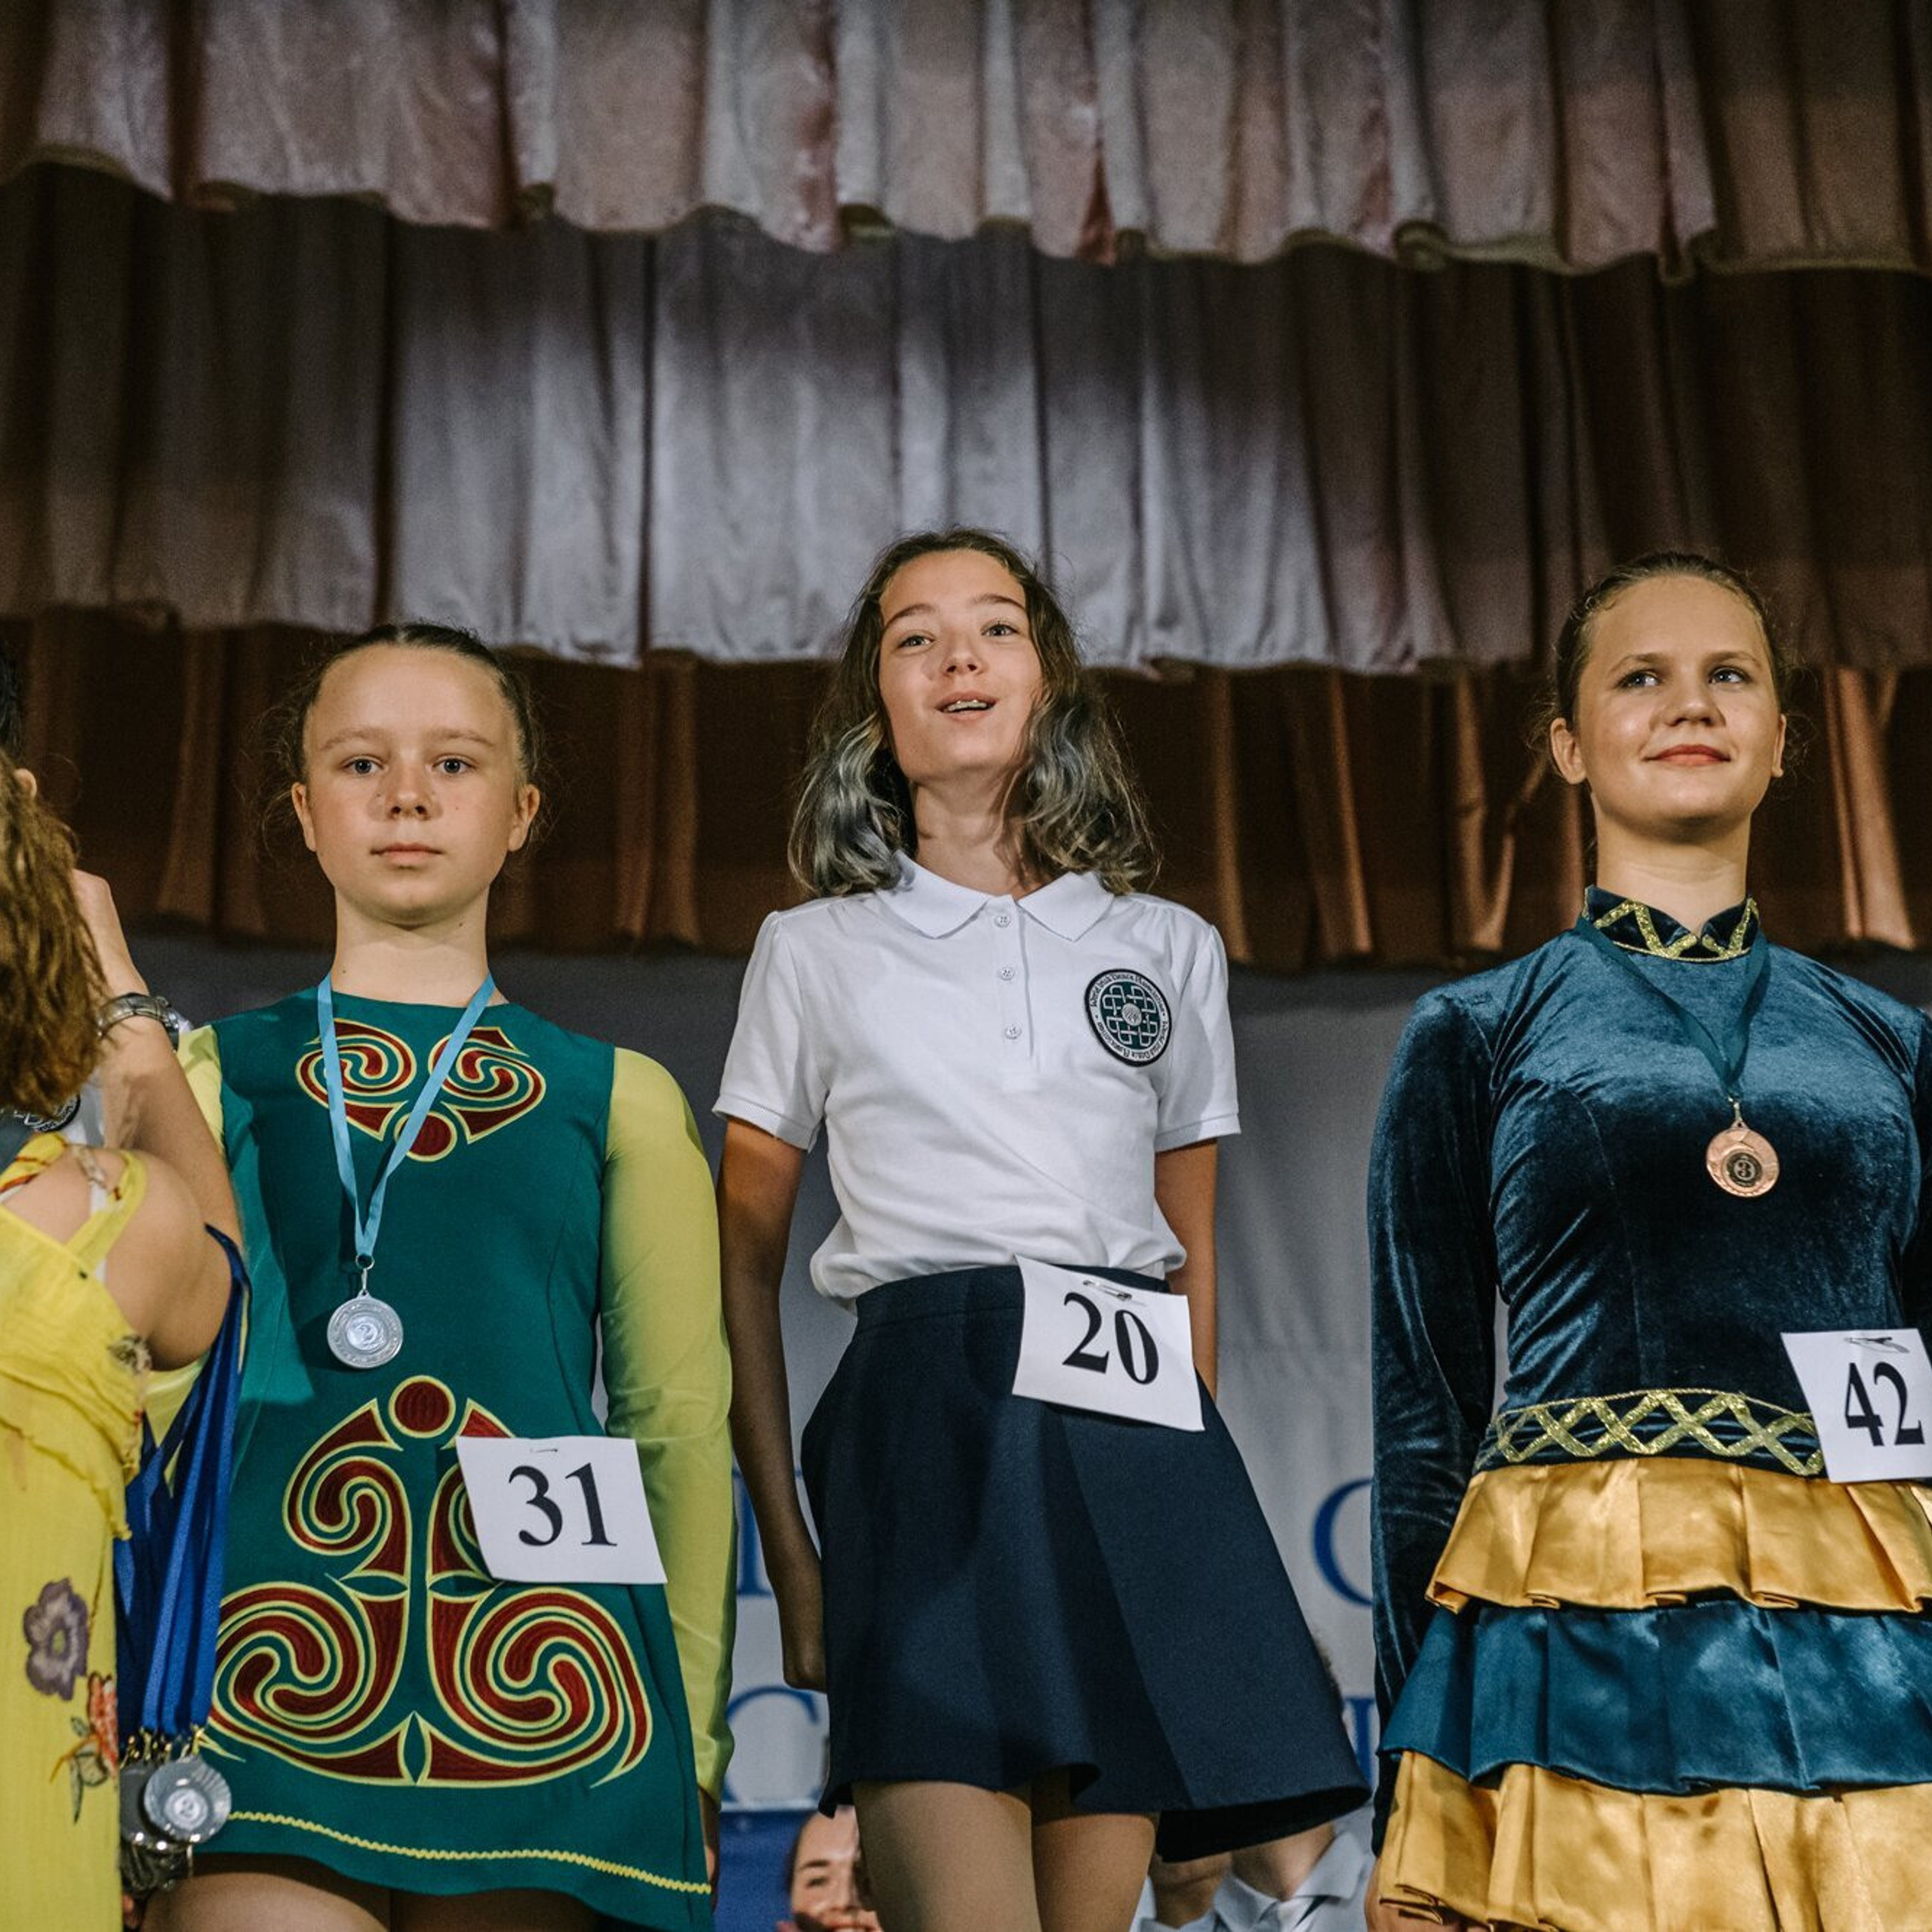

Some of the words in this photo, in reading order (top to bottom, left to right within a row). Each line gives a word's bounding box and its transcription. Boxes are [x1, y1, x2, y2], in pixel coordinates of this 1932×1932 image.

[1062, 1292, 1159, 1385] 20
[1845, 1361, 1924, 1446] 42
[509, 1463, 617, 1546] 31
